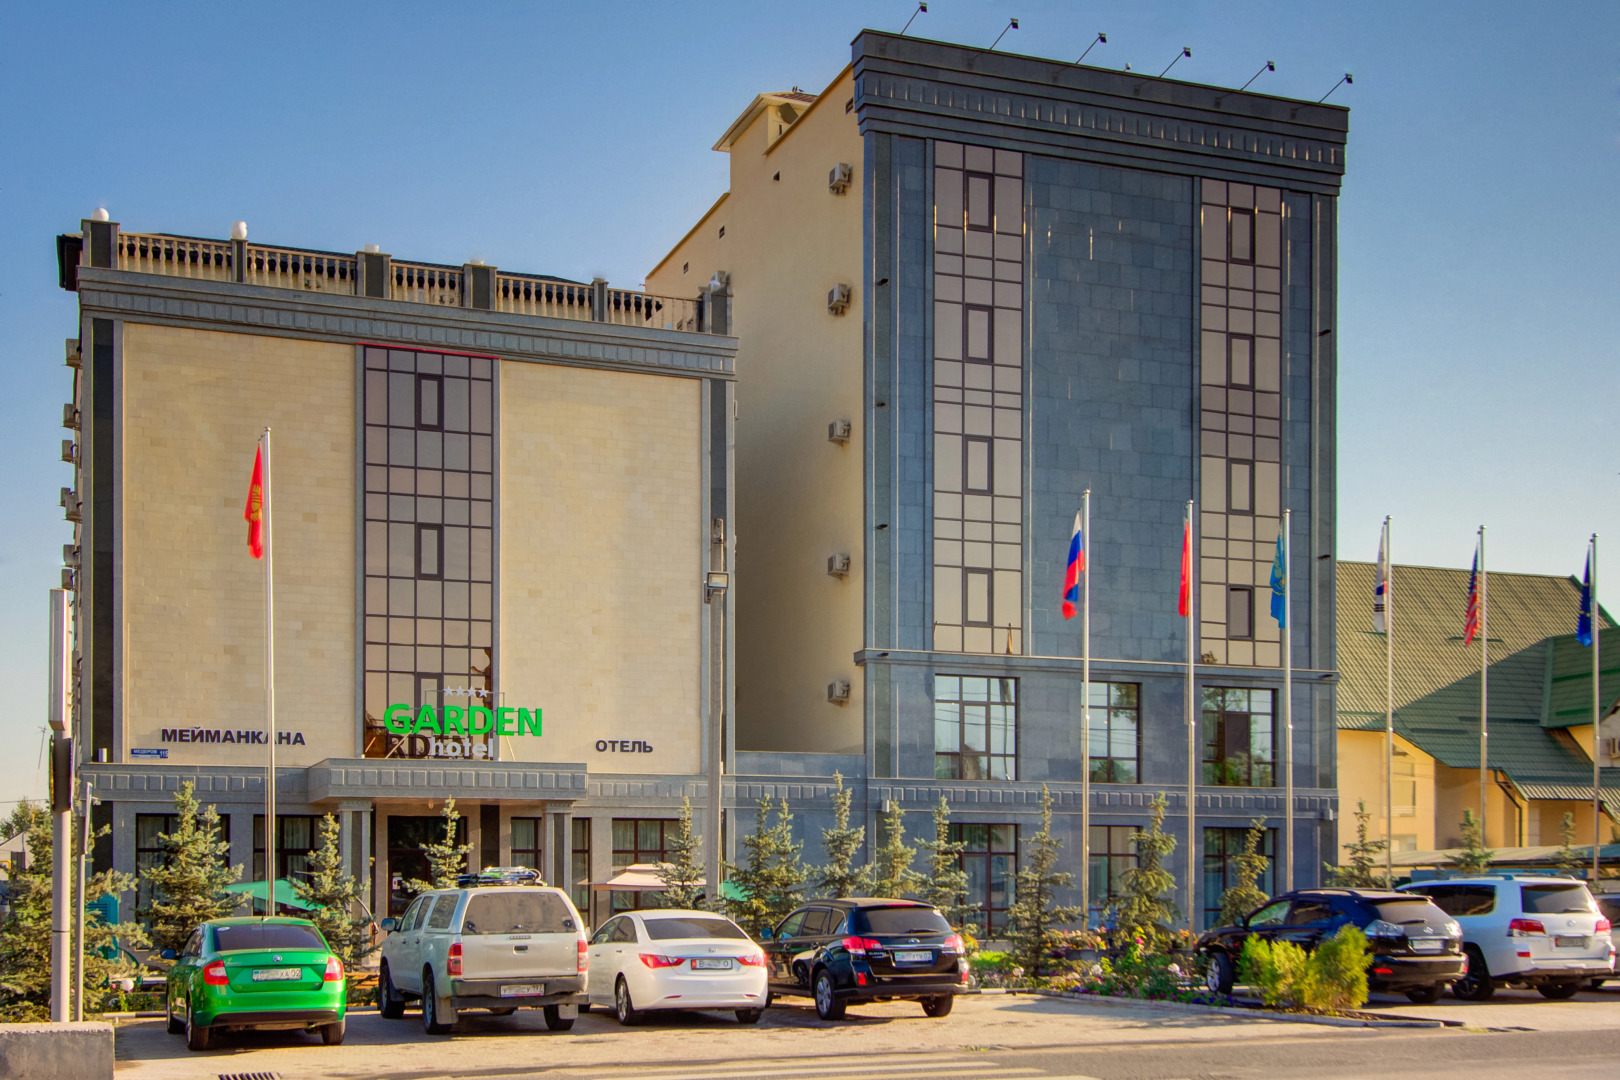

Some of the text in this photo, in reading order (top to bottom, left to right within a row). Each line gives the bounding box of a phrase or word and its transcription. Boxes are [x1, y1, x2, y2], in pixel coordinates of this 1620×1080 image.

[384, 703, 543, 737] GARDEN
[431, 736, 494, 758] hotel
[595, 739, 654, 753] ОТЕЛЬ
